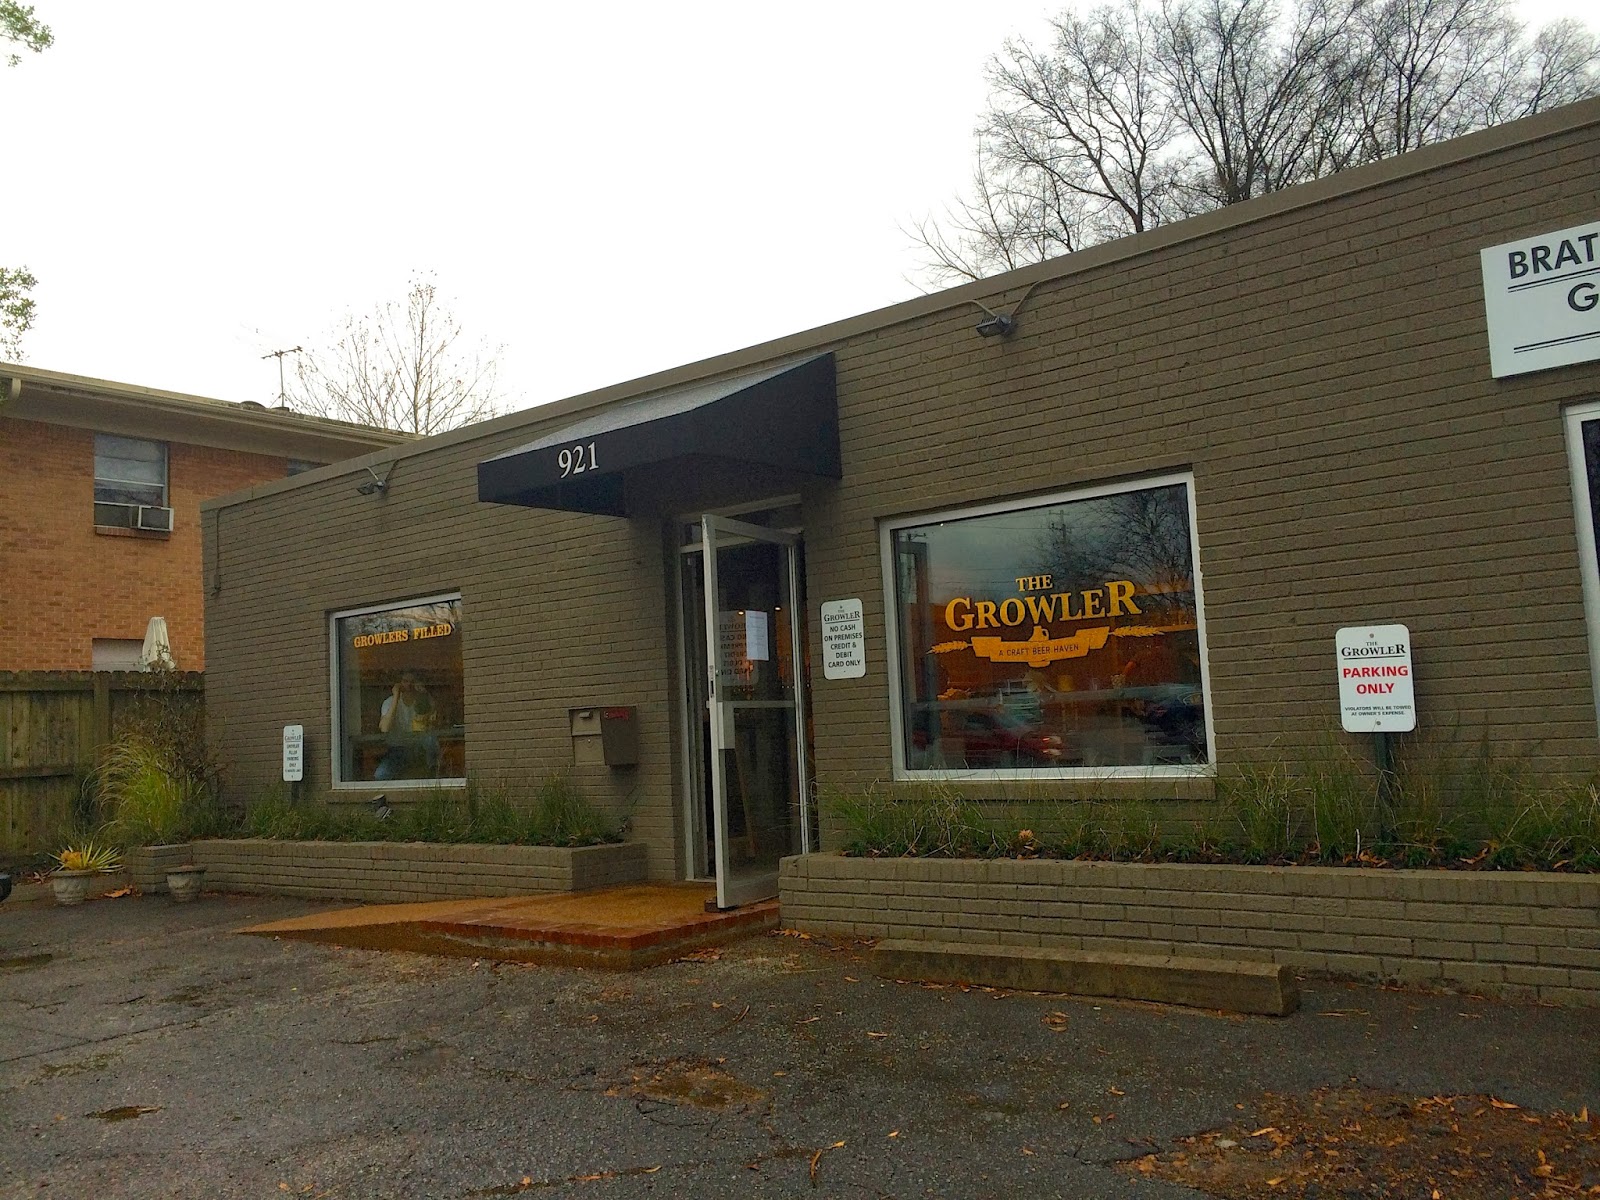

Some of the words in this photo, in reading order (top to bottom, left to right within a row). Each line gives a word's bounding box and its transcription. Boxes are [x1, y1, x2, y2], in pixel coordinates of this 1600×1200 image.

[558, 441, 599, 479] 921
[1015, 574, 1053, 592] THE
[944, 580, 1142, 631] GROWLER
[824, 610, 861, 622] GROWLER
[353, 629, 408, 648] GROWLERS
[413, 623, 452, 640] FILLED
[834, 632, 863, 641] PREMISES
[830, 642, 851, 650] CREDIT
[1006, 648, 1029, 656] CRAFT
[1032, 646, 1051, 655] BEER
[1053, 644, 1079, 653] HAVEN
[1341, 644, 1406, 657] GROWLER
[845, 659, 861, 667] ONLY
[1343, 665, 1408, 678] PARKING
[1356, 683, 1395, 694] ONLY
